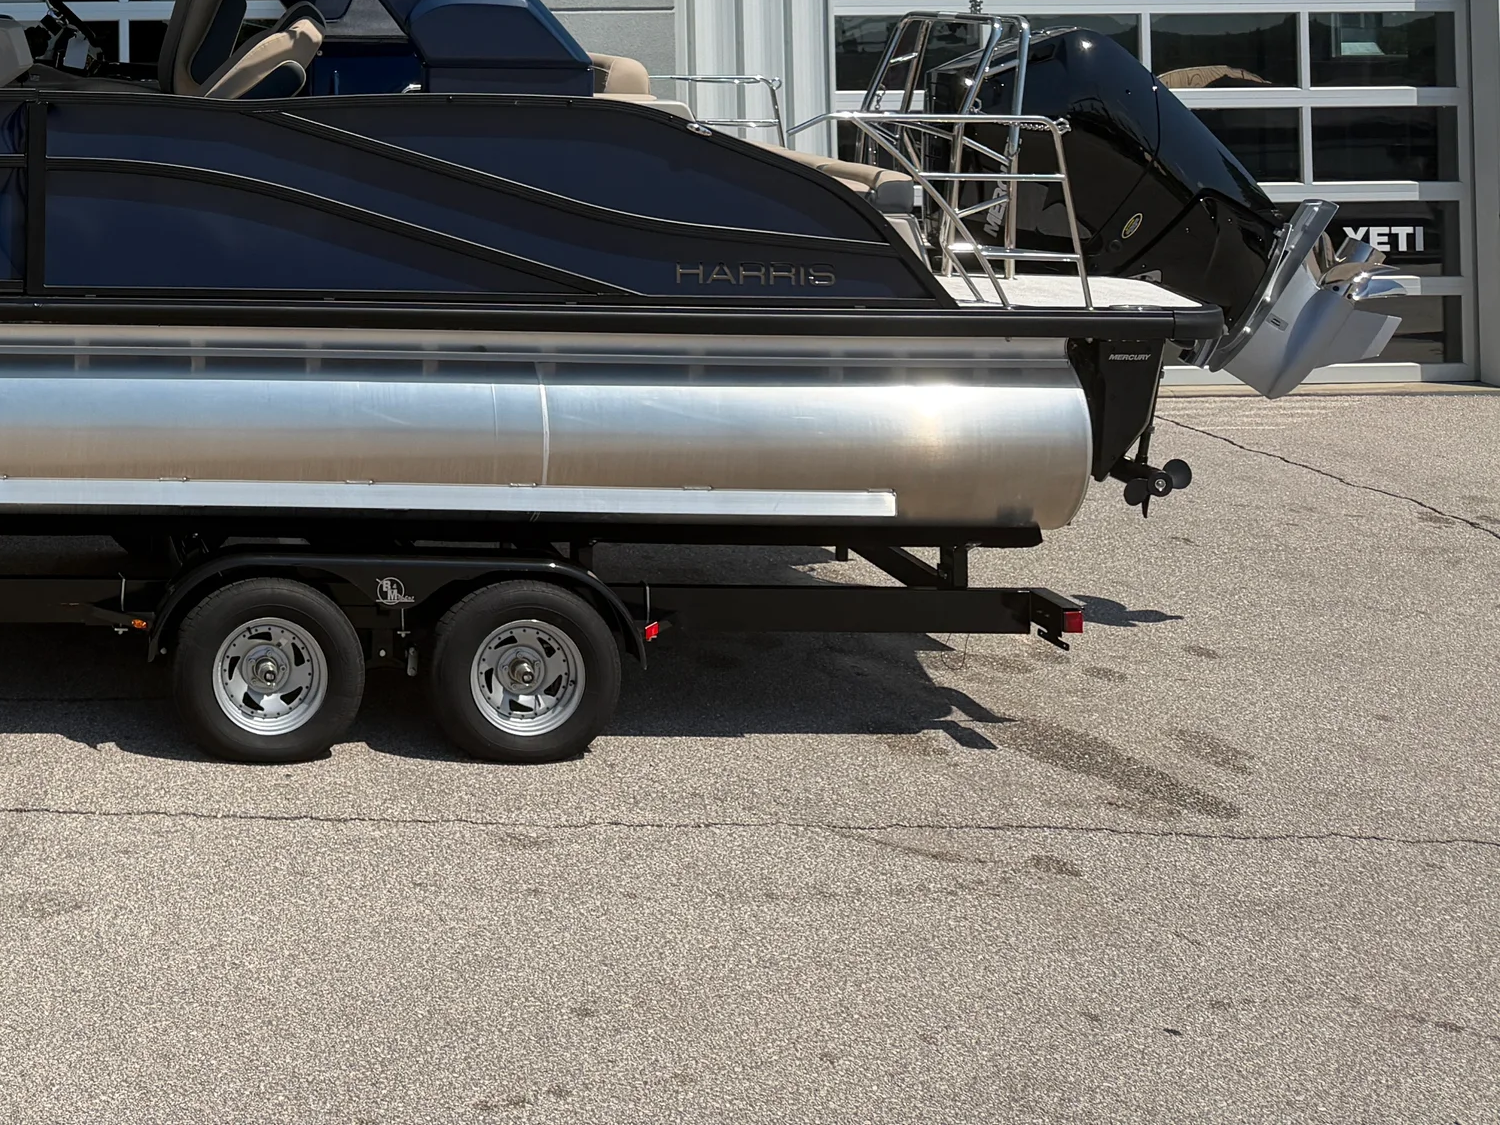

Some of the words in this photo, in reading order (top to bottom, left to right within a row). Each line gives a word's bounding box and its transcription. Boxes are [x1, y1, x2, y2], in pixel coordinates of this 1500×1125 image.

[1342, 226, 1425, 253] YETI
[675, 260, 837, 287] HARRIS
[1108, 353, 1152, 361] MERCURY
